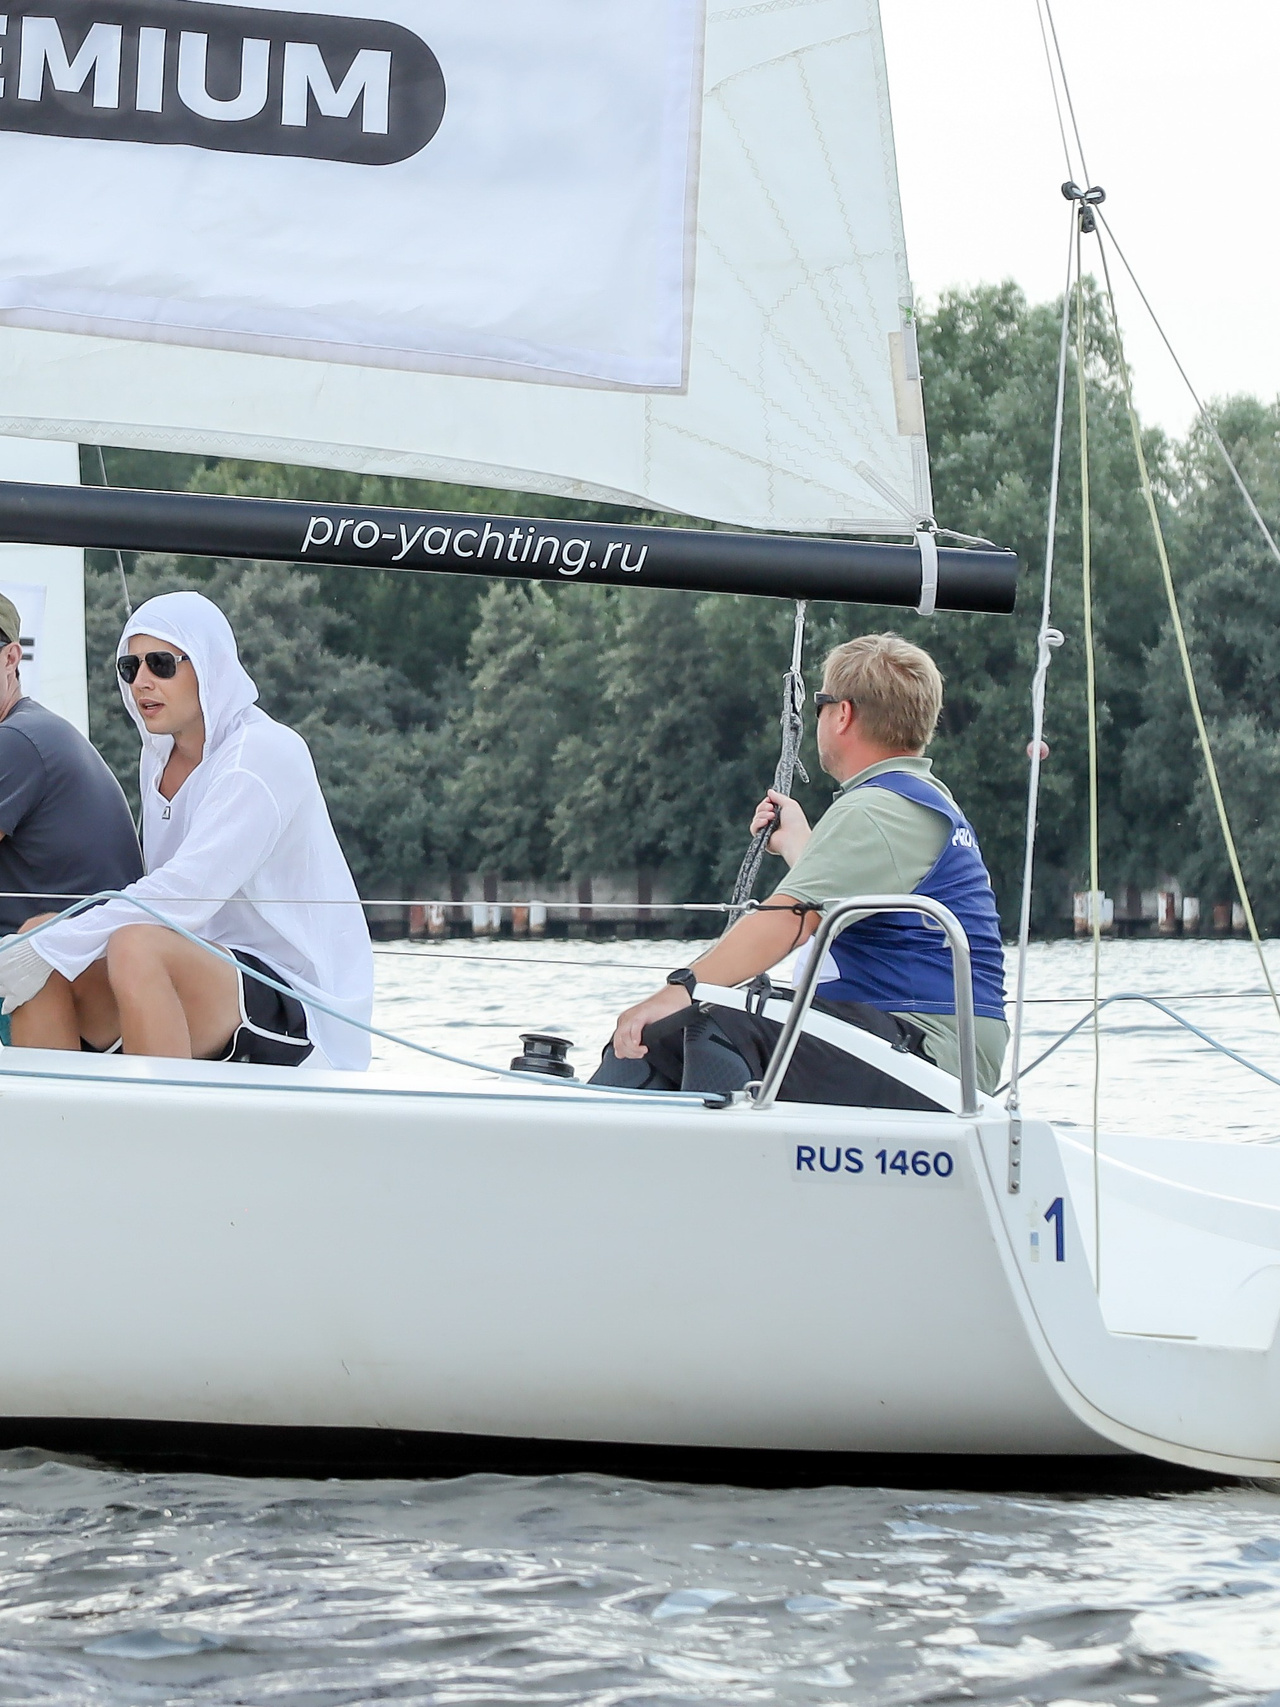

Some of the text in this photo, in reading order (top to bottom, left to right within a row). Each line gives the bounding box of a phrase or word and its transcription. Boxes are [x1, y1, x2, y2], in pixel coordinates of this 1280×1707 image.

[300, 515, 649, 576] pro-yachting.ru
[796, 1145, 954, 1178] RUS 1460
[1043, 1196, 1066, 1262] 1
